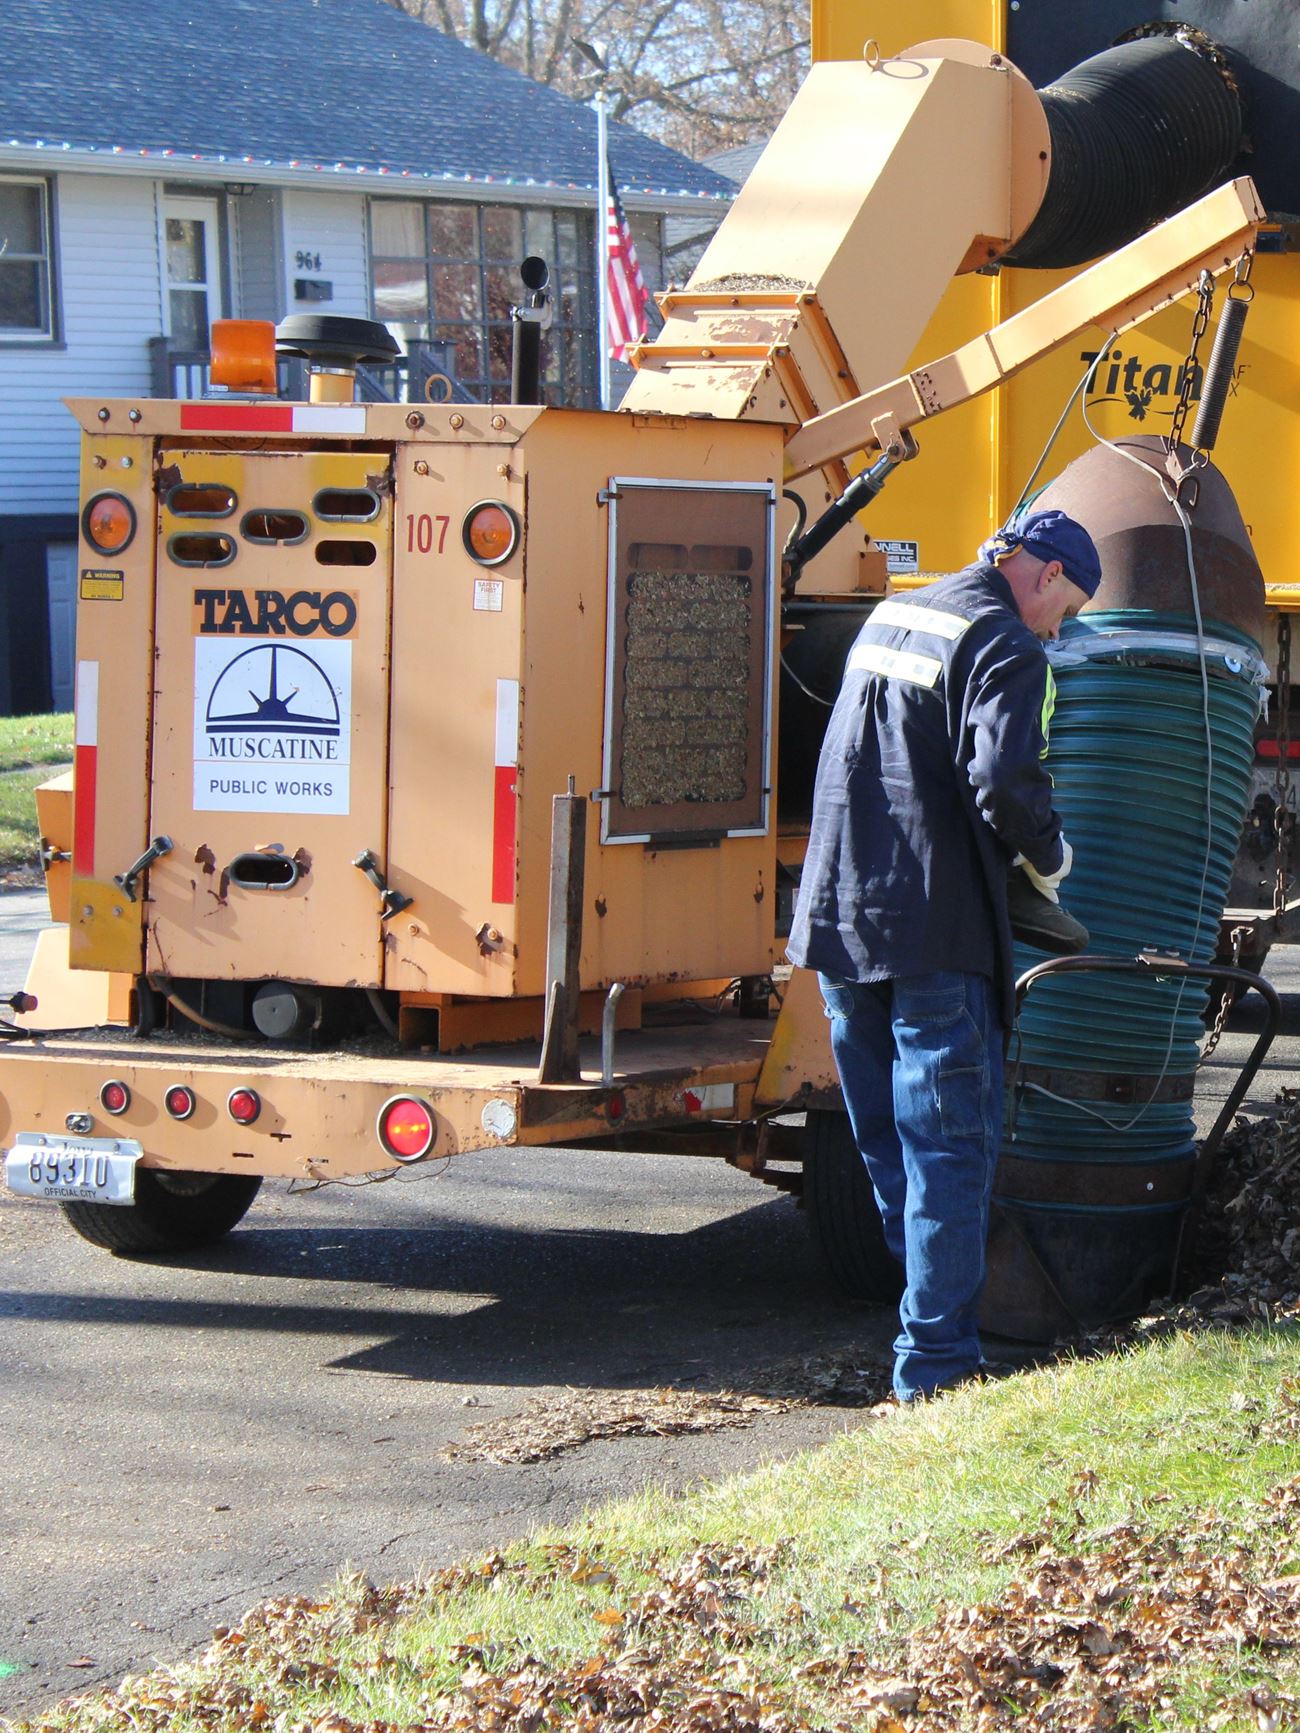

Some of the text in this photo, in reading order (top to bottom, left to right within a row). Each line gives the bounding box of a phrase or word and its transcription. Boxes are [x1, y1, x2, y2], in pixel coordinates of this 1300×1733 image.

[1080, 349, 1202, 401] Titan
[406, 514, 450, 554] 107
[194, 589, 357, 637] TARCO
[208, 736, 338, 760] MUSCATINE
[209, 779, 333, 797] PUBLIC WORKS
[28, 1151, 109, 1188] 89310
[44, 1187, 97, 1199] OFFICIAL CITY
